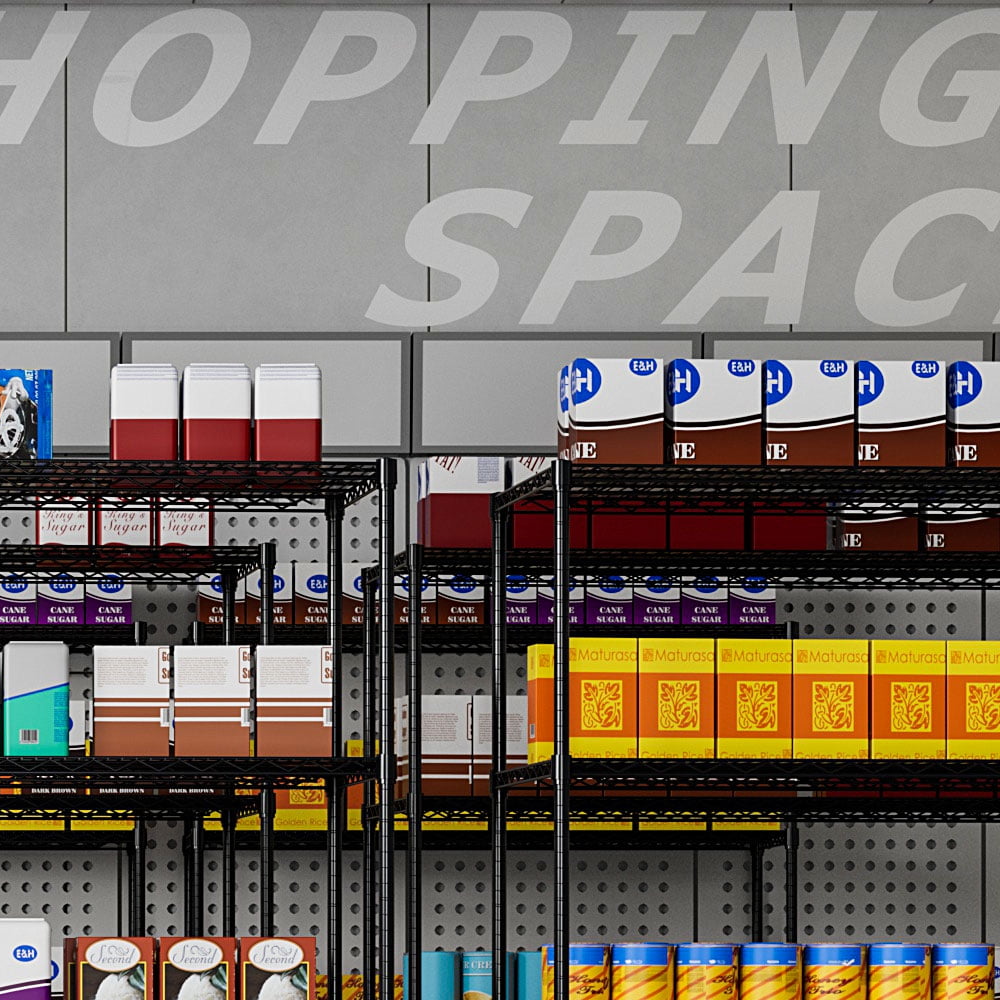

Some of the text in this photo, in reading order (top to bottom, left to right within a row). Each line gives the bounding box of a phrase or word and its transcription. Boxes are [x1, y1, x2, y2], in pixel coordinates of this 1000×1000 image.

[365, 187, 1000, 327] SPAC
[633, 360, 654, 371] E&H
[731, 361, 752, 372] E&H
[824, 362, 844, 373] E&H
[915, 363, 936, 373] E&H
[41, 519, 86, 535] Sugar
[162, 520, 206, 536] Sugar
[50, 606, 74, 614] CANE
[98, 606, 122, 614] CANE
[599, 606, 623, 614] CANE
[742, 606, 766, 614] CANE
[276, 818, 307, 826] Golden
[16, 949, 34, 958] E&H
[90, 945, 133, 965] Second
[172, 945, 216, 965] Second
[253, 945, 297, 965] Second
